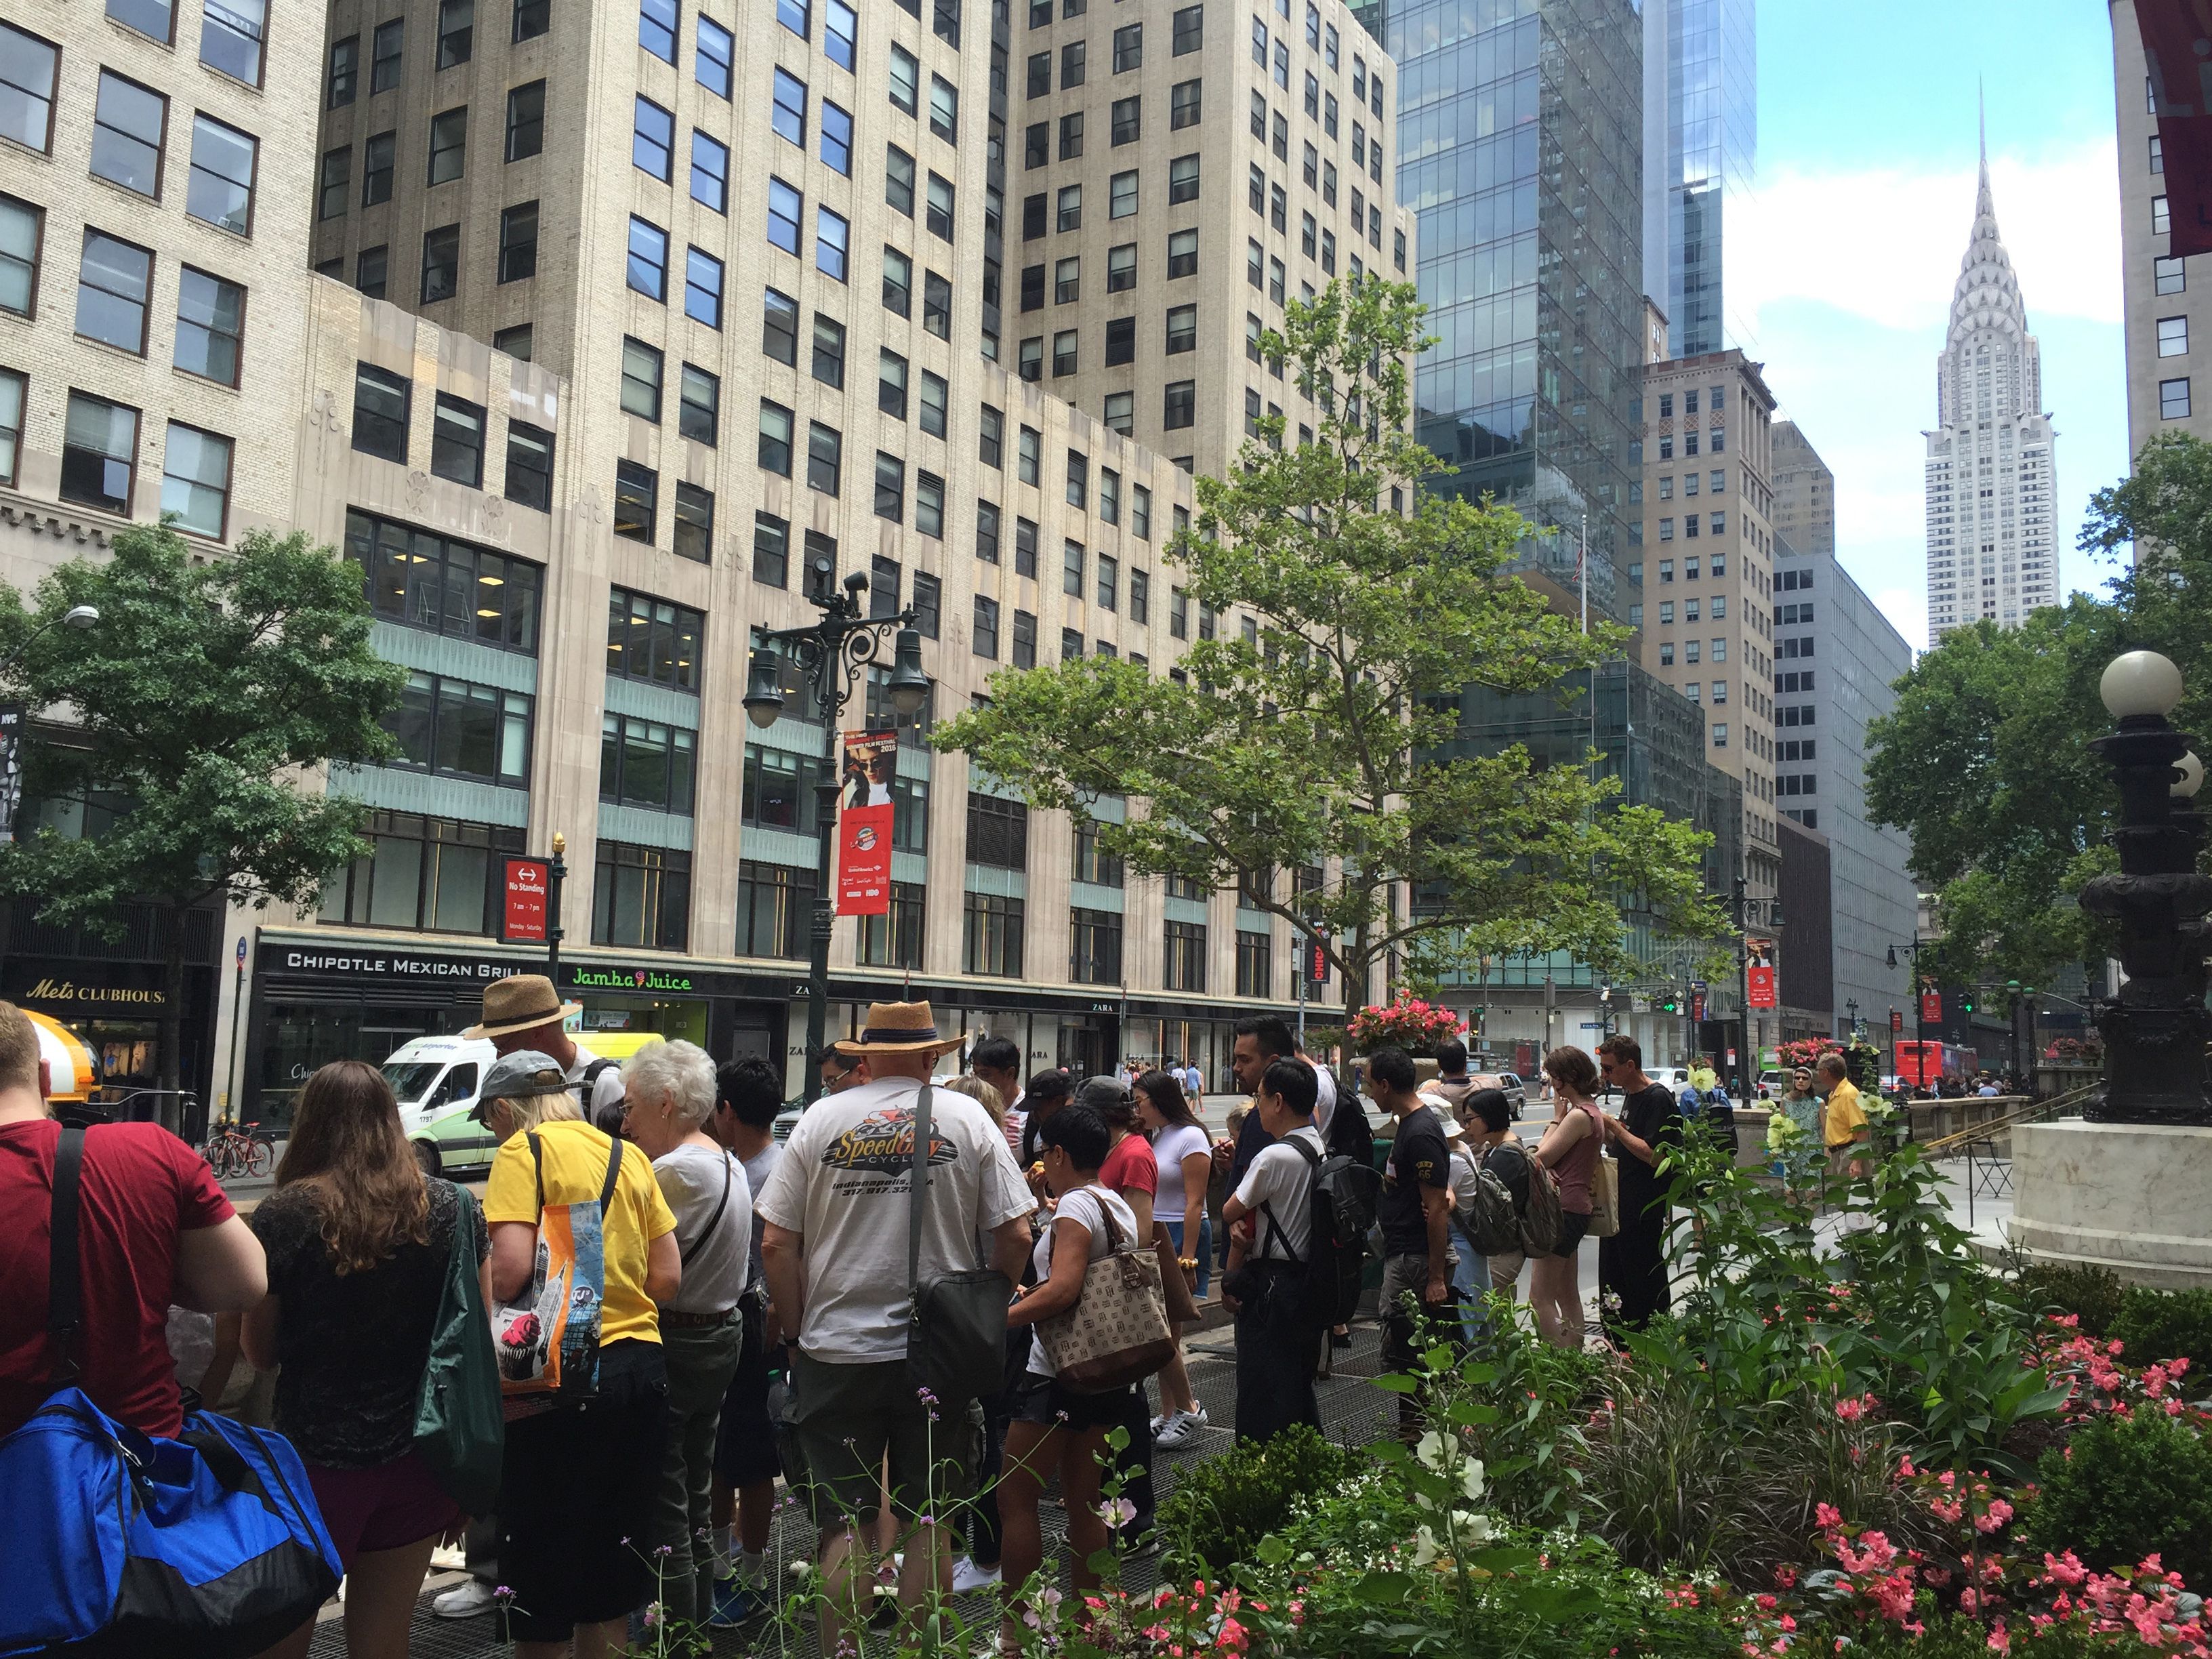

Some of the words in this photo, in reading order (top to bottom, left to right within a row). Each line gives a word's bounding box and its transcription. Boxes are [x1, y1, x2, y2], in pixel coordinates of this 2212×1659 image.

[1, 714, 17, 724] NYC
[880, 744, 897, 753] 2016
[509, 882, 518, 890] No
[519, 883, 545, 895] Standing
[1314, 928, 1324, 980] CHIC
[287, 953, 386, 972] CHIPOTLE
[393, 959, 472, 977] MEXICAN
[573, 968, 634, 987] Jamba
[646, 972, 693, 990] Juice
[26, 979, 74, 999] Mets
[78, 987, 165, 1003] CLUBHOUS
[796, 985, 810, 995] ZA
[1092, 1004, 1113, 1012] ZARA
[1031, 1051, 1048, 1059] ARA
[1418, 1169, 1431, 1179] 66
